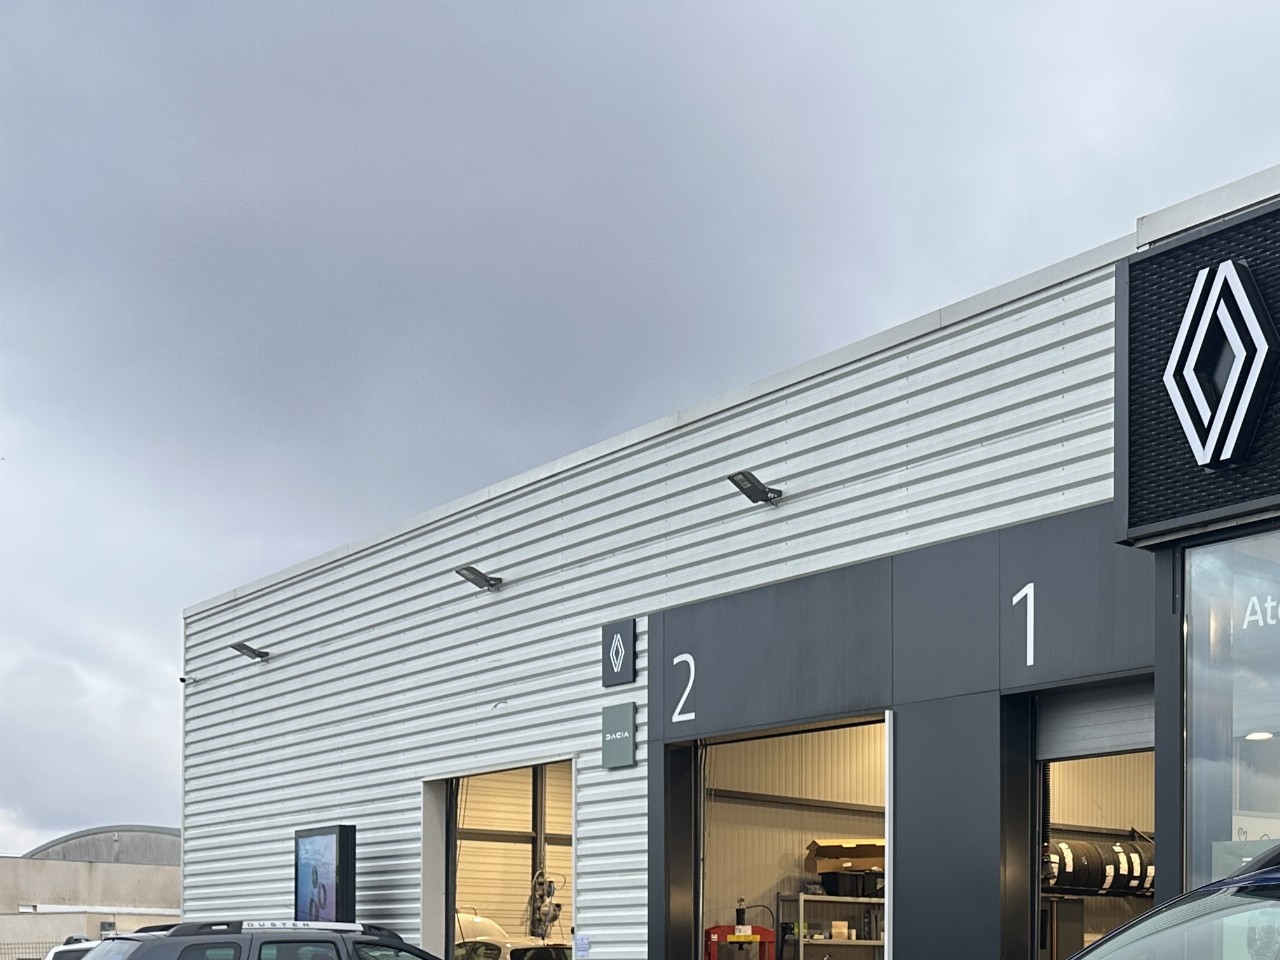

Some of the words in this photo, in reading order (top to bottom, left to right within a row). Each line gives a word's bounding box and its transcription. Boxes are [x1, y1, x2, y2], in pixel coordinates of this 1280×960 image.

[1011, 582, 1035, 667] 1
[671, 653, 697, 723] 2
[605, 731, 629, 741] DACIA
